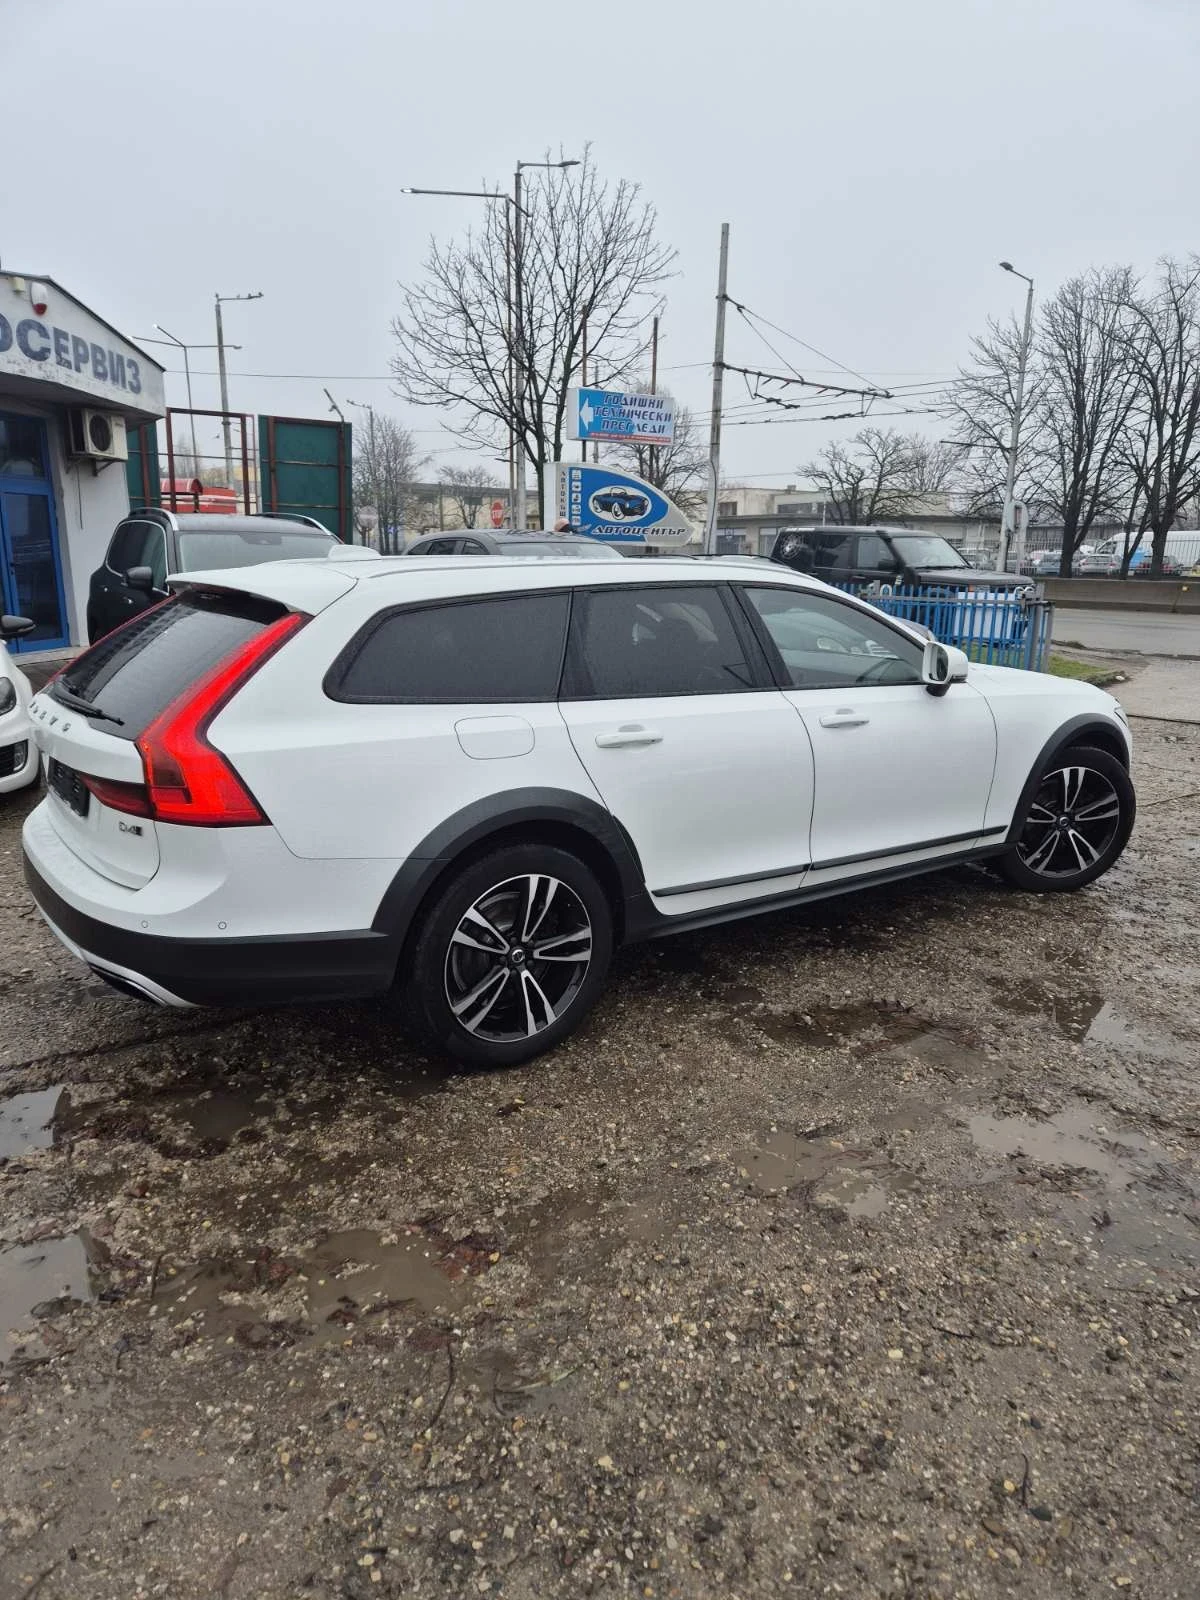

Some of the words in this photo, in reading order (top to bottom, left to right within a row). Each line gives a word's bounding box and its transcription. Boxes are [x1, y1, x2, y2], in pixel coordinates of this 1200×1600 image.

[604, 394, 664, 409] ГОДИШНИ
[595, 406, 672, 422] ТЕХНИЧЕСКИ
[602, 419, 665, 434] ПРЕГЛЕДИ
[592, 526, 686, 536] АВТОЦЕНТЪР
